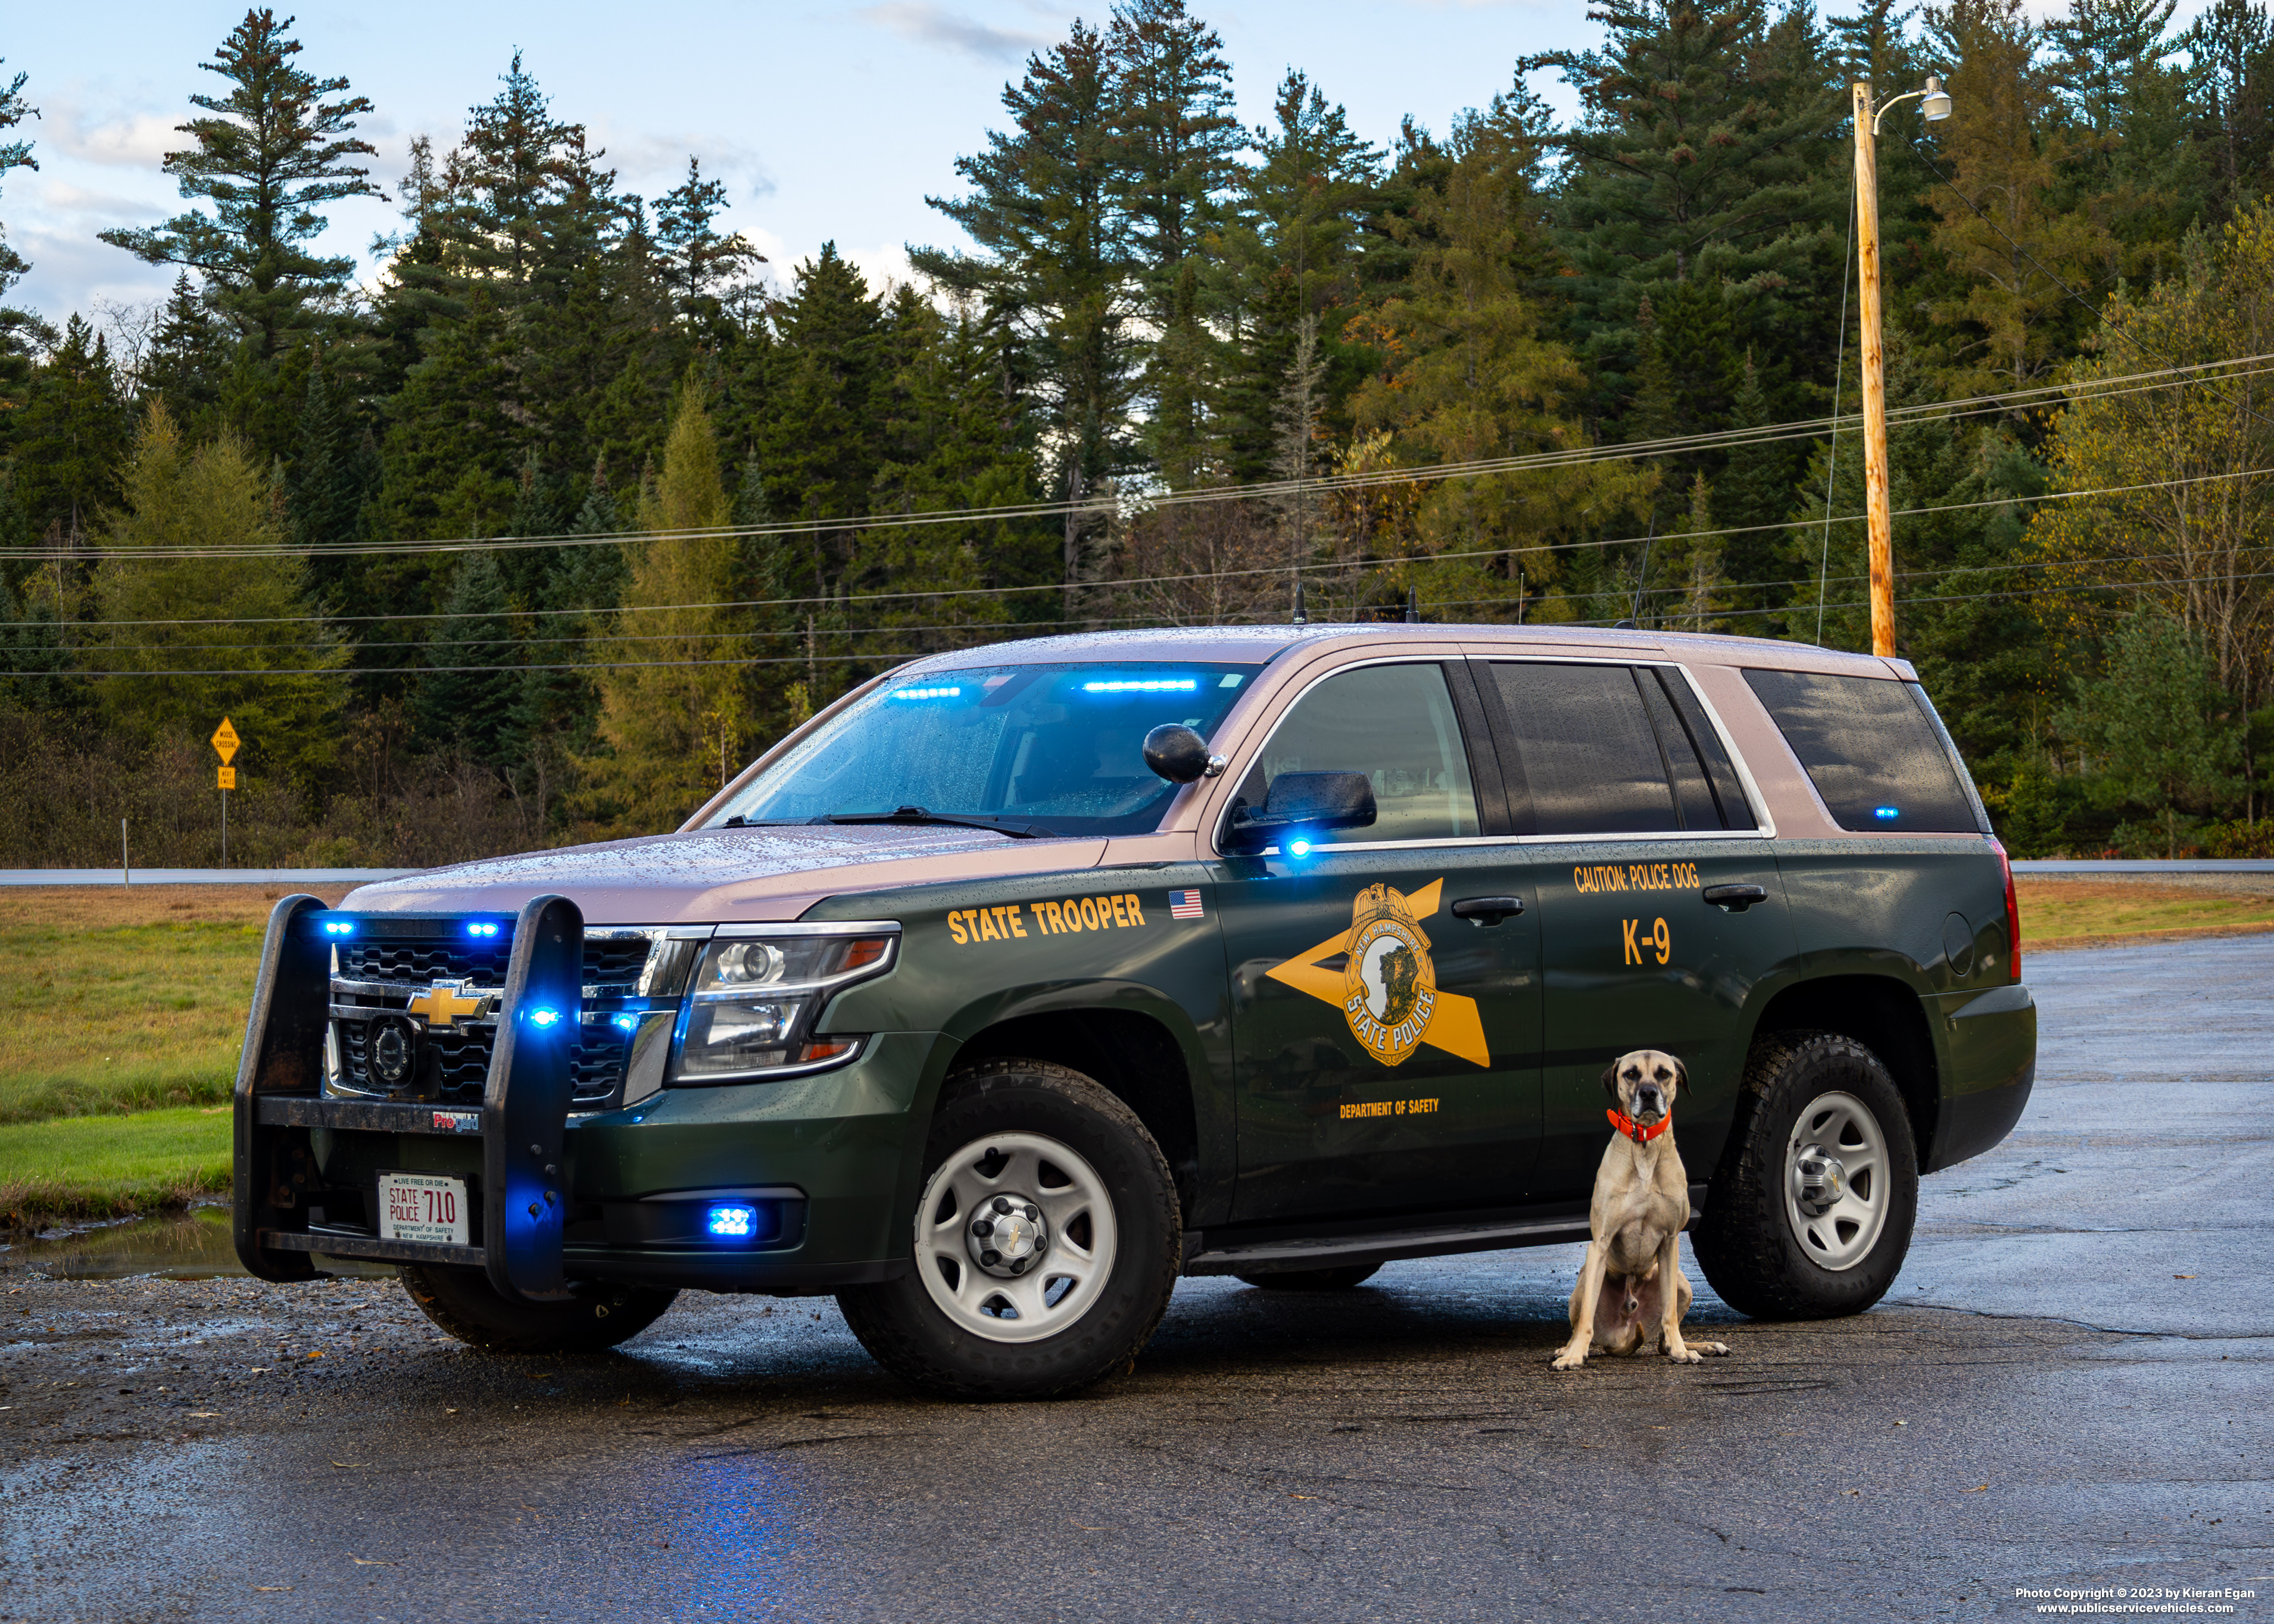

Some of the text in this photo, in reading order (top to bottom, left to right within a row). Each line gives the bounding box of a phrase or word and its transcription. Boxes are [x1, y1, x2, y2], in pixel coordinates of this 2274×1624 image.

[1574, 863, 1700, 893] CAUTION: POLICE DOG
[947, 894, 1146, 945] STATE TROOPER
[1356, 923, 1420, 957] NEW HAMPSHIRE
[1623, 917, 1670, 965] K-9
[1347, 988, 1435, 1051] STATE POLICE
[1340, 1098, 1439, 1119] DEPARTMENT OF SAFETY
[389, 1188, 456, 1224] STATE 710
[390, 1205, 420, 1222] POLICE
